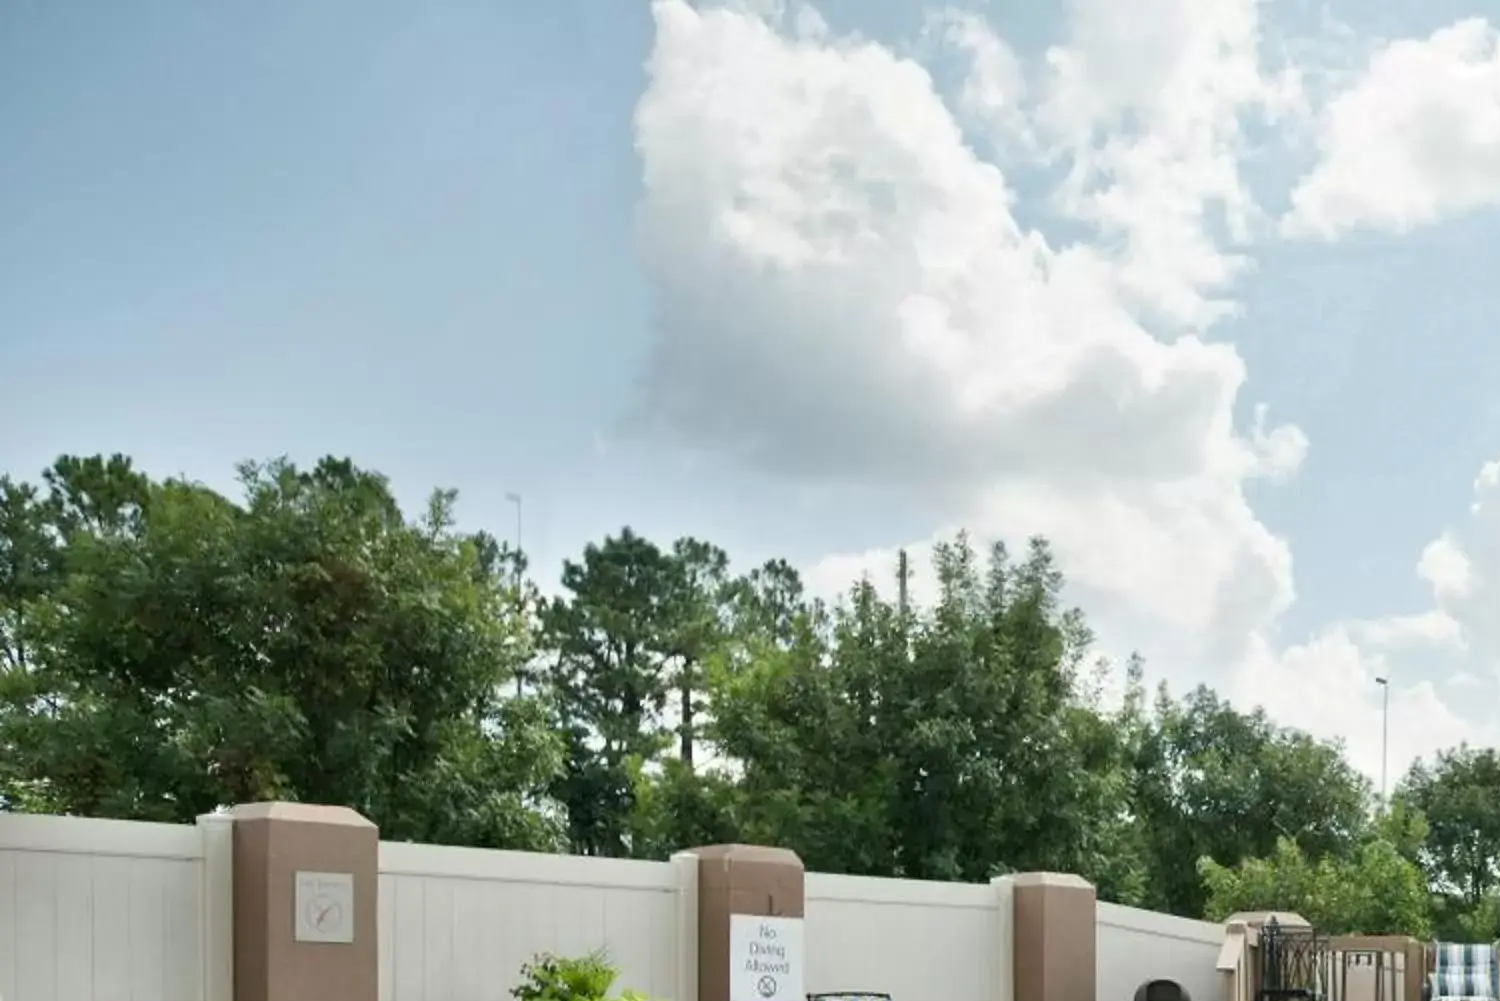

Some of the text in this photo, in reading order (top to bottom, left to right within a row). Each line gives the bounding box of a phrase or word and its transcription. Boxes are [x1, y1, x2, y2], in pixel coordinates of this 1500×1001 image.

[759, 923, 777, 939] No
[749, 942, 785, 958] Diving
[745, 959, 790, 974] Allowed
